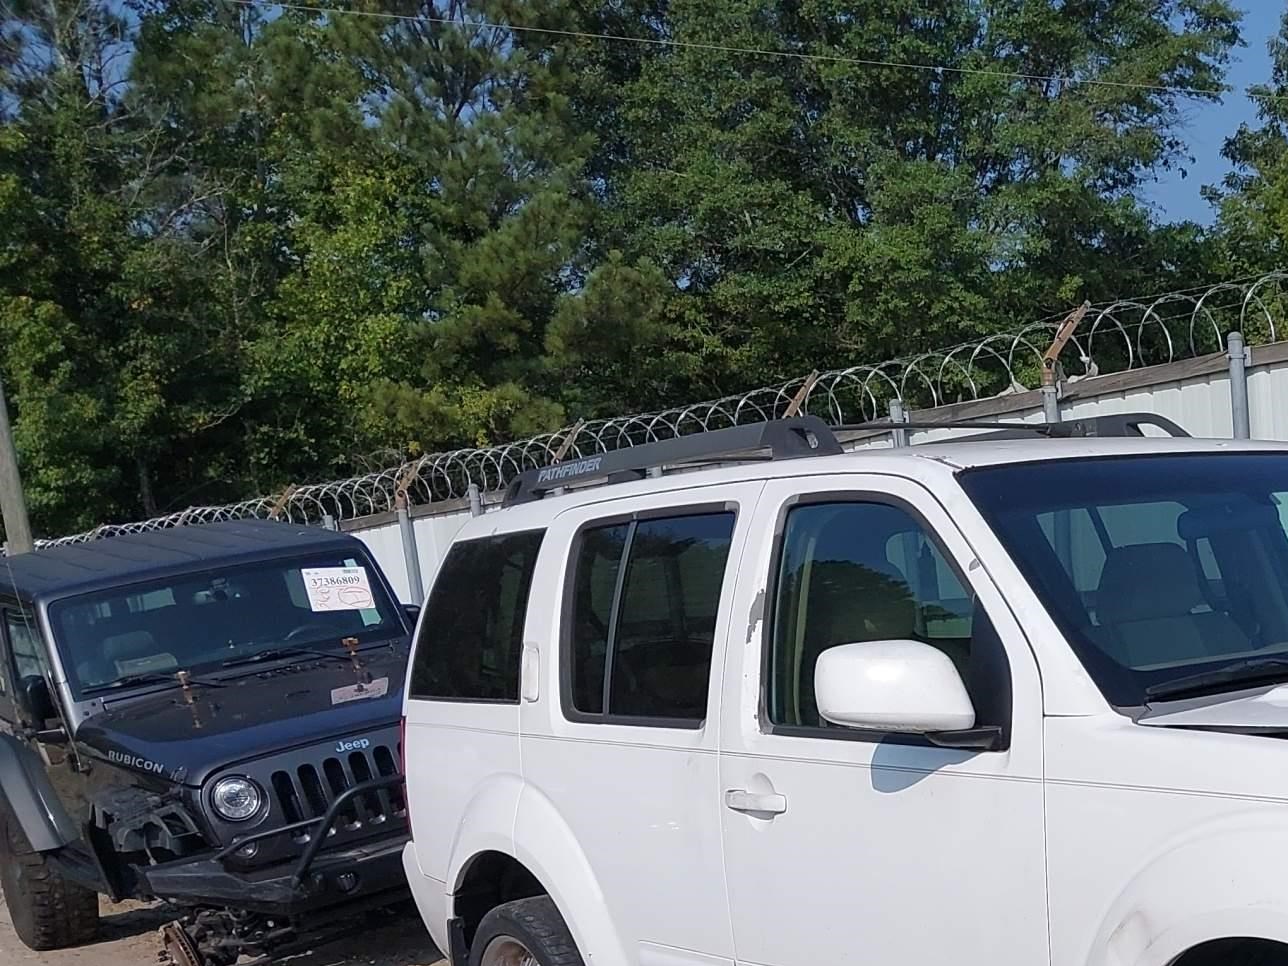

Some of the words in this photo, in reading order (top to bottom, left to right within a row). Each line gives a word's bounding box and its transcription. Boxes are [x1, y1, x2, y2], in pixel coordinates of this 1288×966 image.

[538, 457, 602, 482] PATHFINDER
[311, 575, 360, 587] 37386809
[335, 738, 370, 752] Jeep
[108, 750, 164, 773] RUBICON
